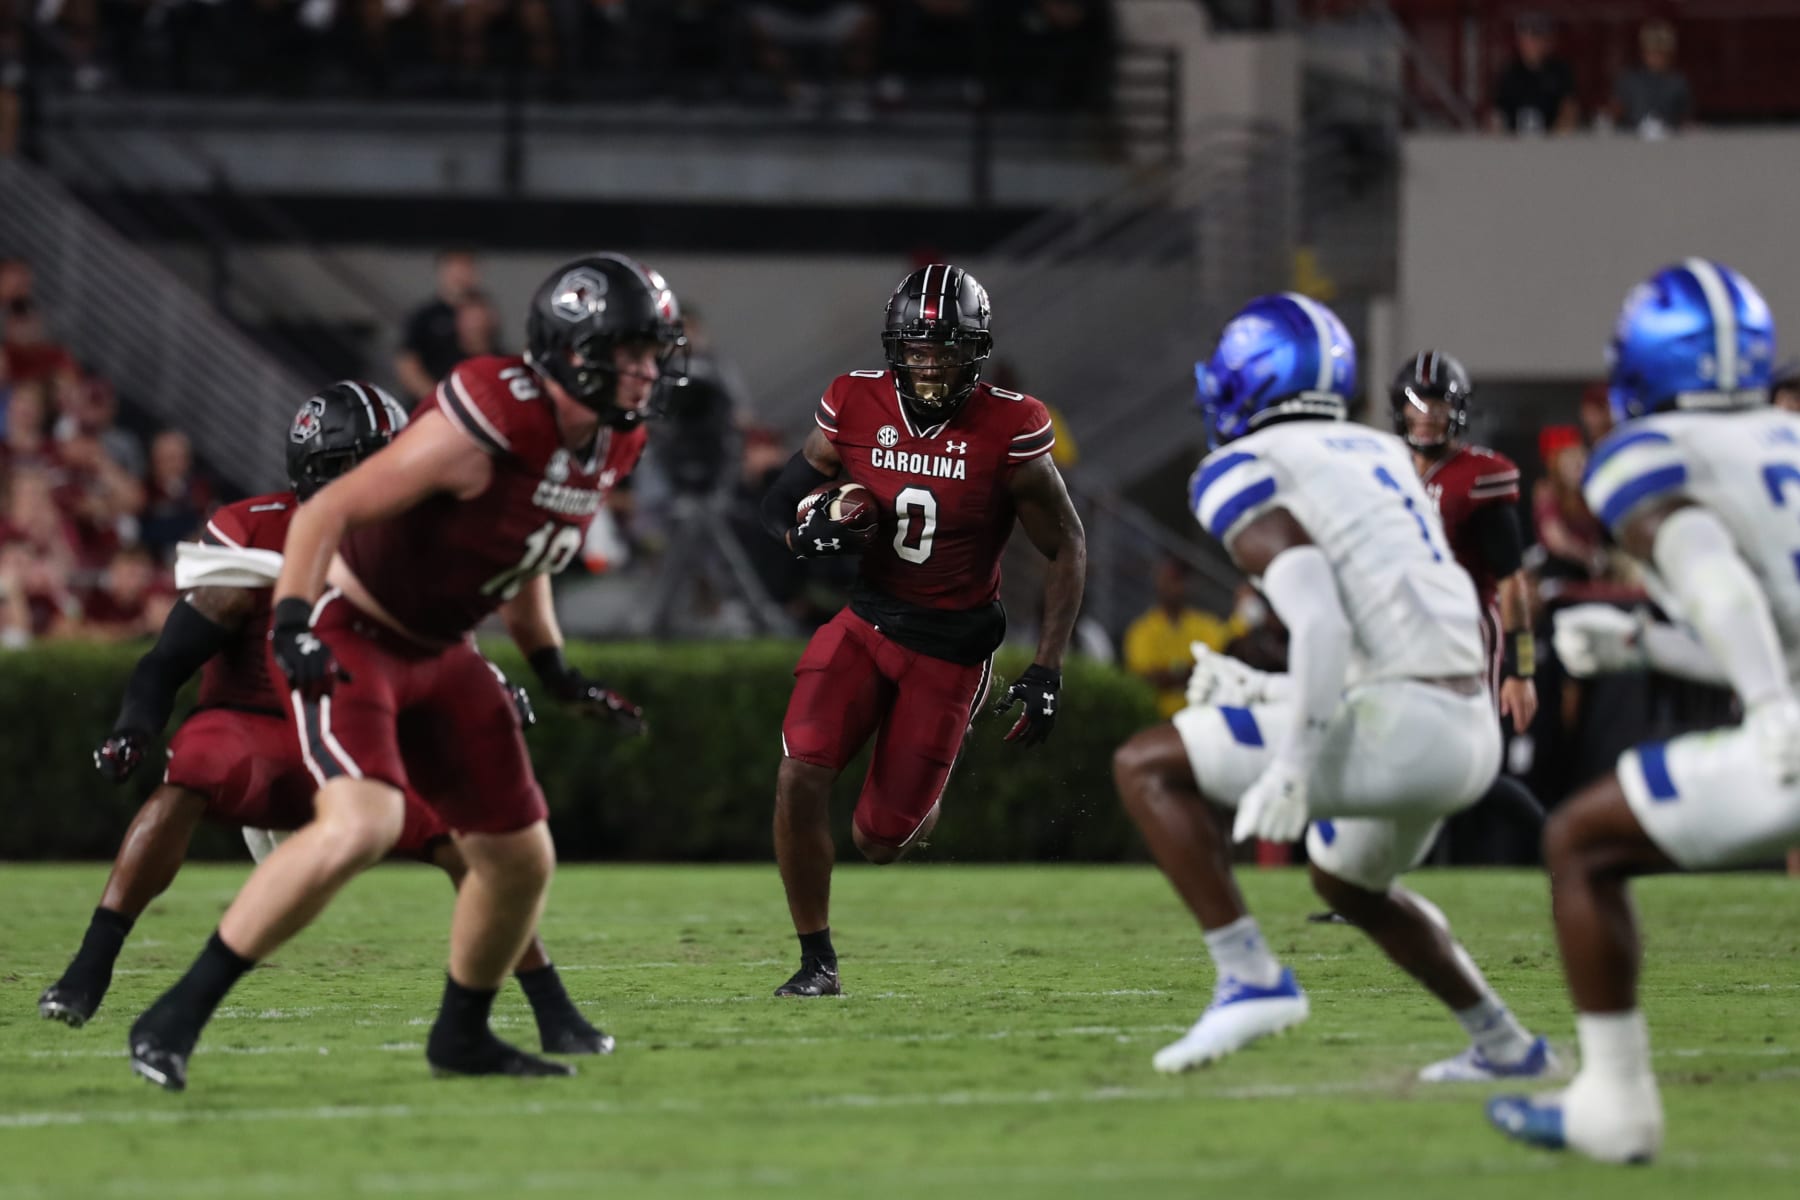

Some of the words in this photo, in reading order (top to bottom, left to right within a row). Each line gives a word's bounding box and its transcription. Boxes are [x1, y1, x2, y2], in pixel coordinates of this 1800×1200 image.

[879, 427, 897, 446] SEC
[872, 448, 965, 480] CAROLINA
[894, 488, 936, 564] 0
[1373, 465, 1442, 564] 1
